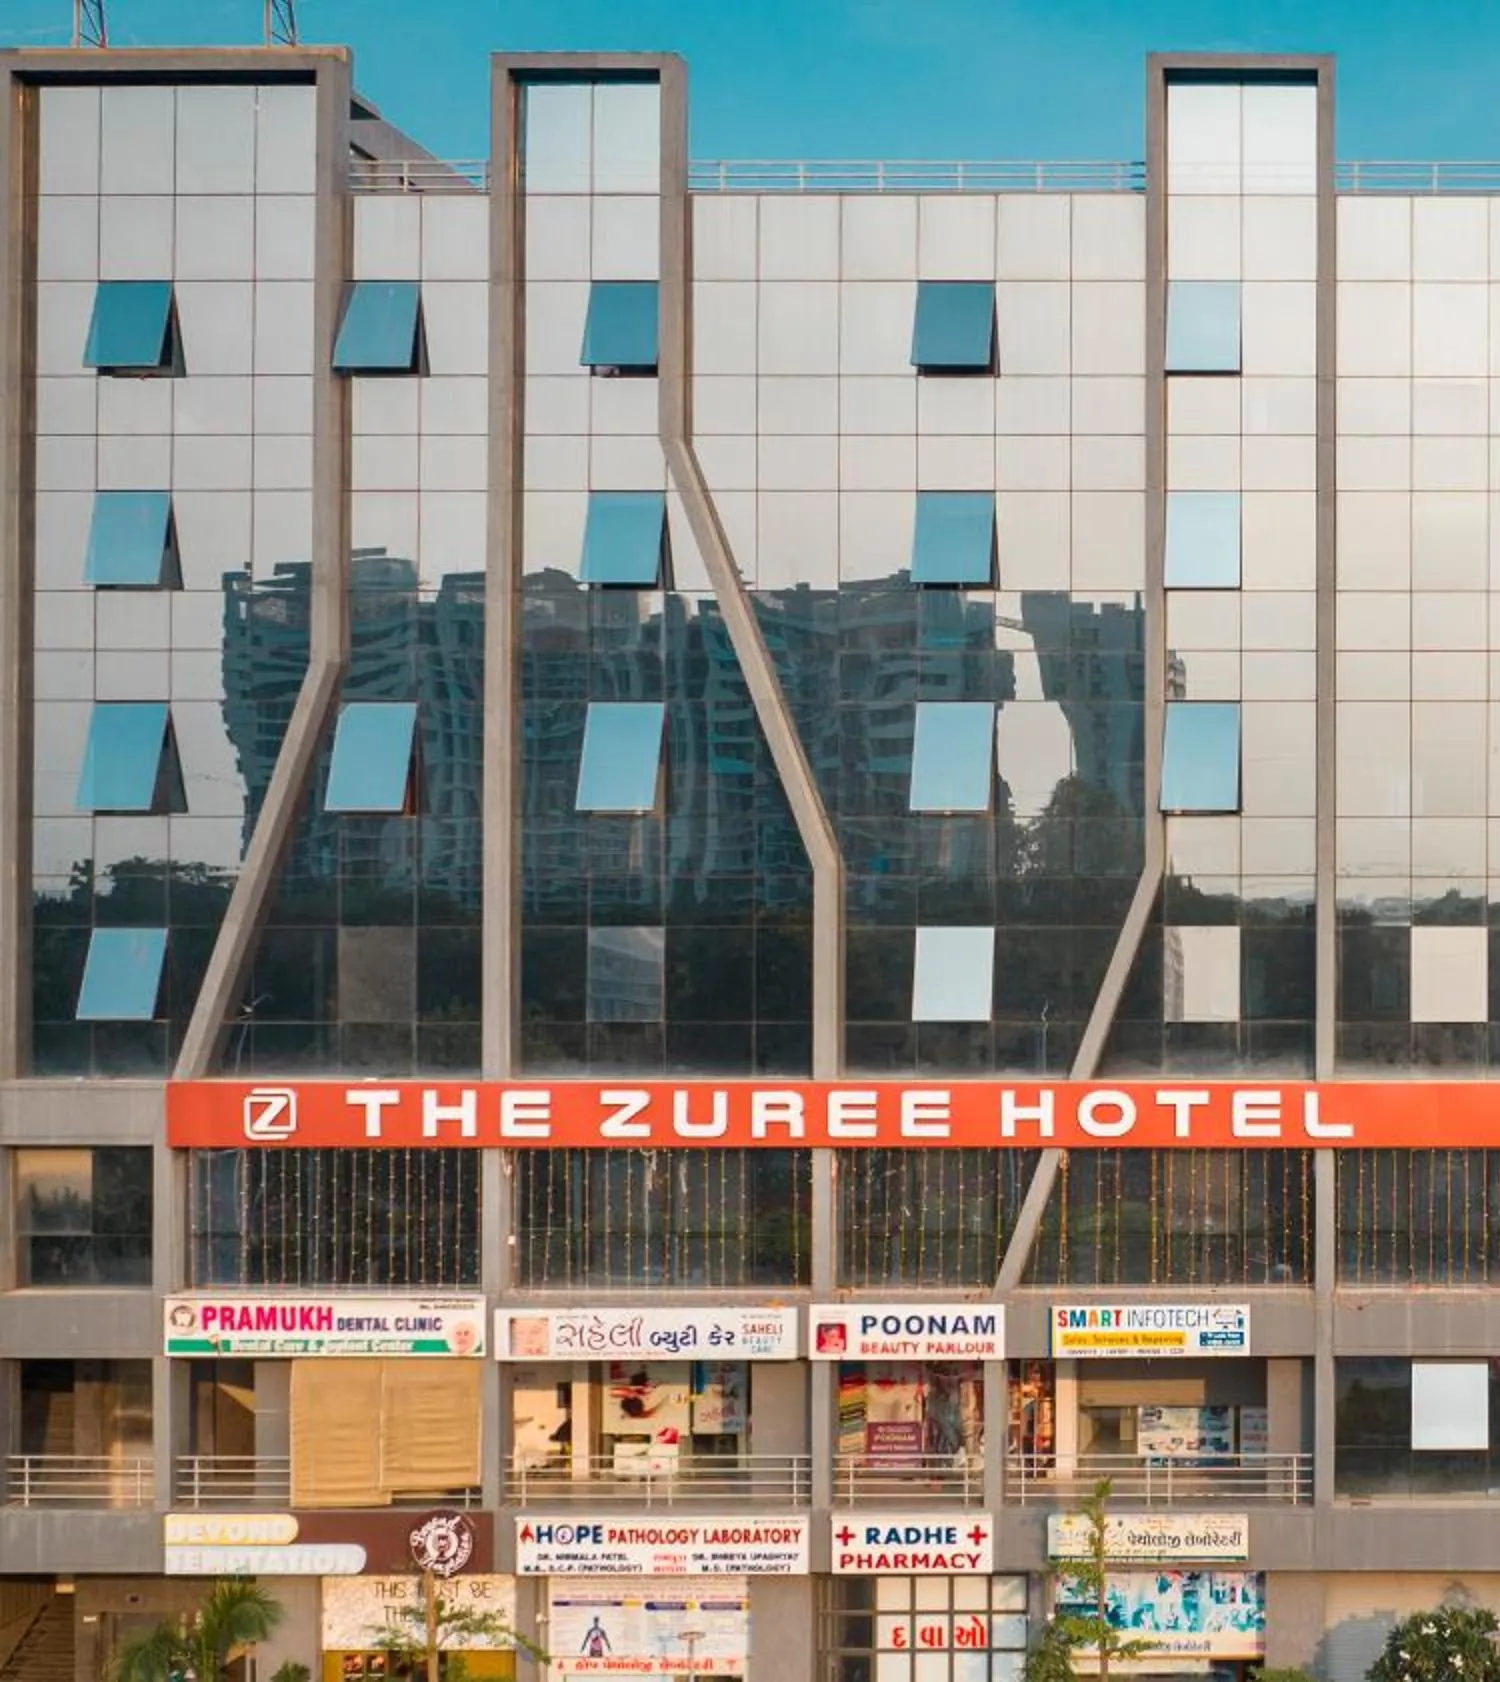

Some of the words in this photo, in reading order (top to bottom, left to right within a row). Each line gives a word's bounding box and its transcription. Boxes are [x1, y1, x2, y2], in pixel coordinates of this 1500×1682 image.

[347, 1089, 551, 1138] THE
[600, 1089, 951, 1138] ZUREE
[1001, 1089, 1354, 1138] HOTEL
[200, 1306, 334, 1332] PRAMUKH
[337, 1318, 389, 1332] DENTAL
[394, 1317, 442, 1332] CLINIC
[861, 1315, 996, 1335] POONAM
[1057, 1309, 1122, 1328] SMART
[1127, 1309, 1209, 1328] INFOTECH
[556, 1316, 643, 1350] સહેલી
[650, 1325, 697, 1353] બ્યુટી
[708, 1324, 735, 1347] કેર
[742, 1324, 783, 1335] SAHELI
[742, 1337, 782, 1345] BEAUTY
[860, 1341, 920, 1354] BEAUTY
[927, 1341, 995, 1354] PARLOUR
[536, 1524, 603, 1545] HOPE
[607, 1528, 699, 1545] PATHOLOGY
[703, 1528, 801, 1545] LABORATORY
[865, 1526, 957, 1545] RADHE
[839, 1552, 982, 1569] PHARMACY
[374, 1581, 407, 1599] THIS
